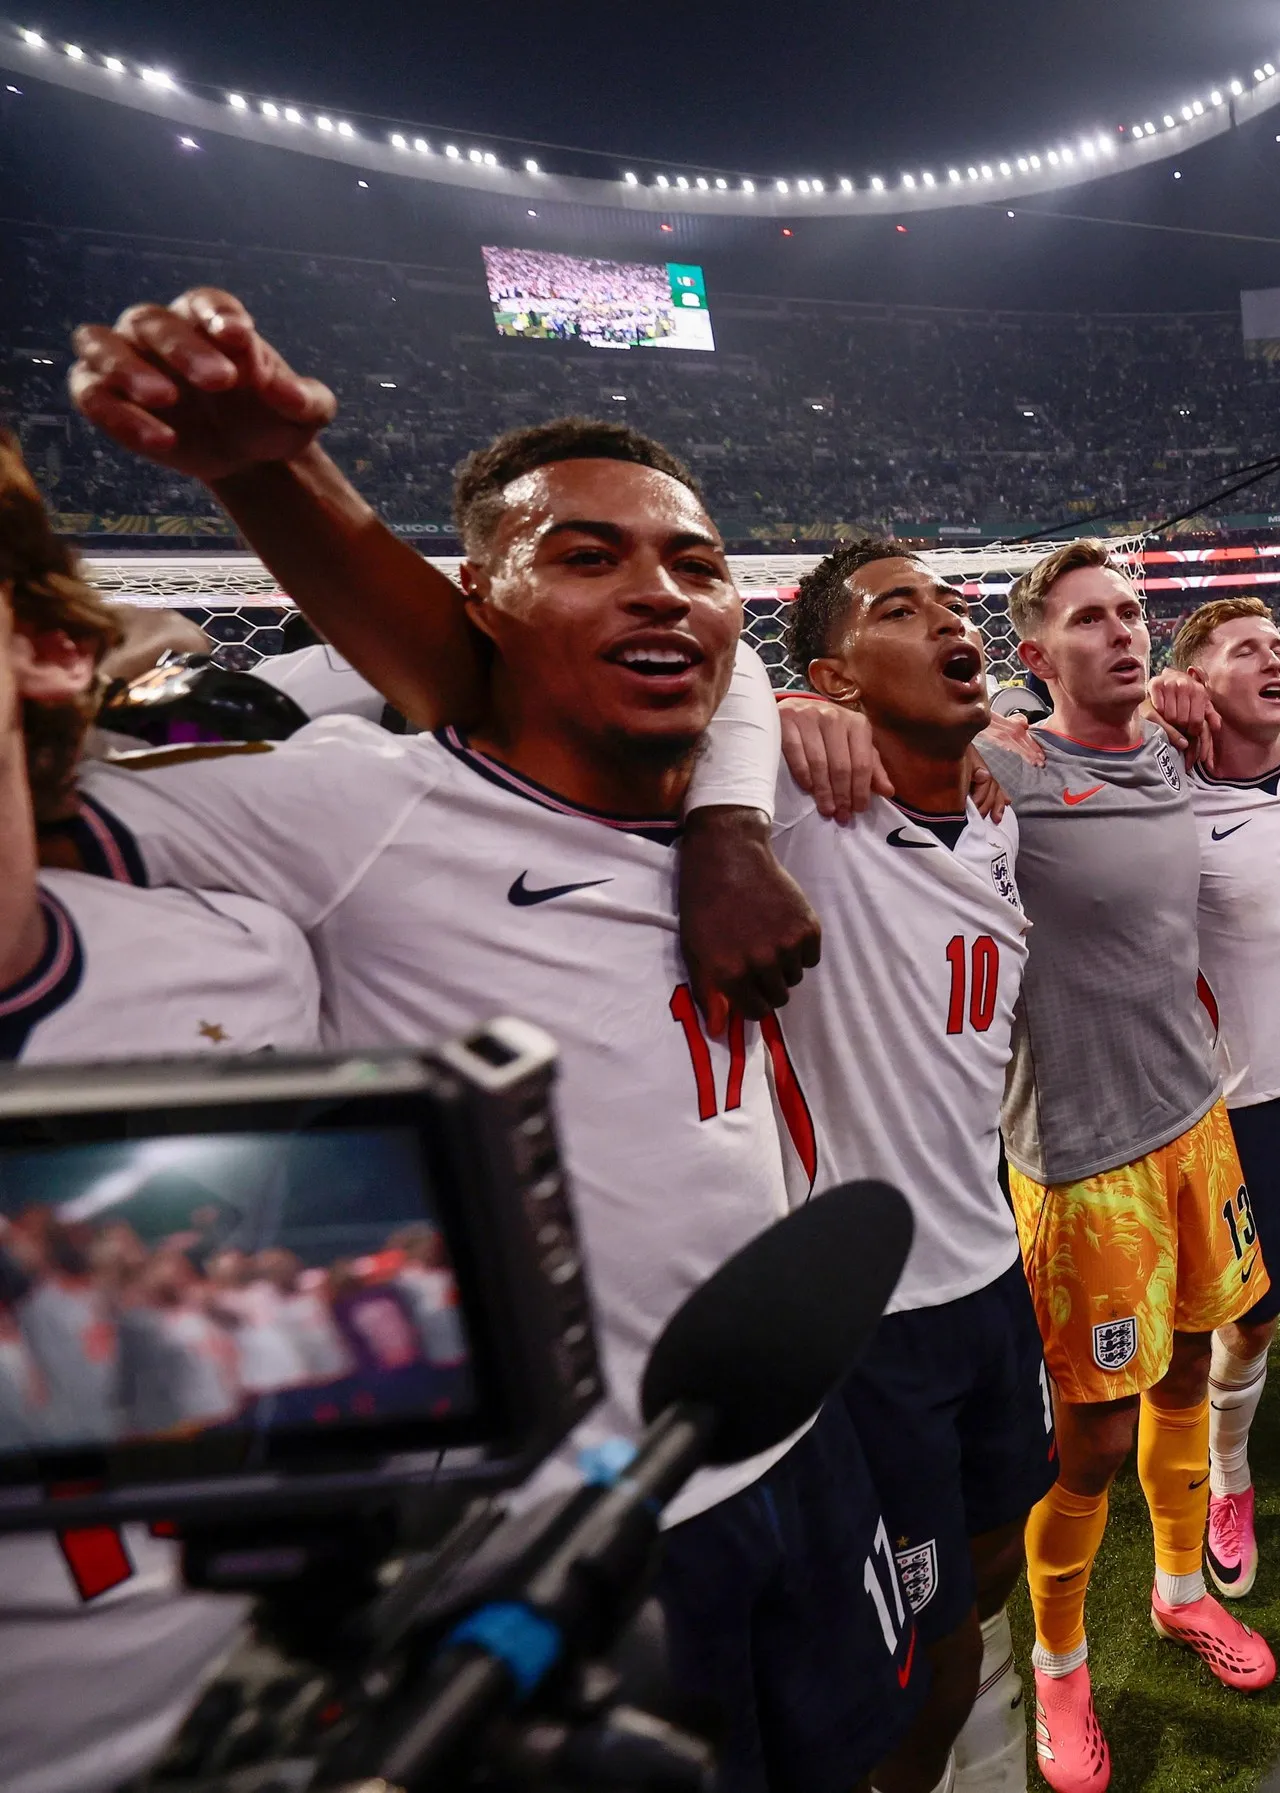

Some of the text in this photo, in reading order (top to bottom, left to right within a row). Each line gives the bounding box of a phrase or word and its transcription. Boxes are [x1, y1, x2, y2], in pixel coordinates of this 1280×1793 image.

[392, 524, 440, 533] XICO
[946, 935, 1000, 1035] 10
[1221, 1184, 1258, 1261] 13
